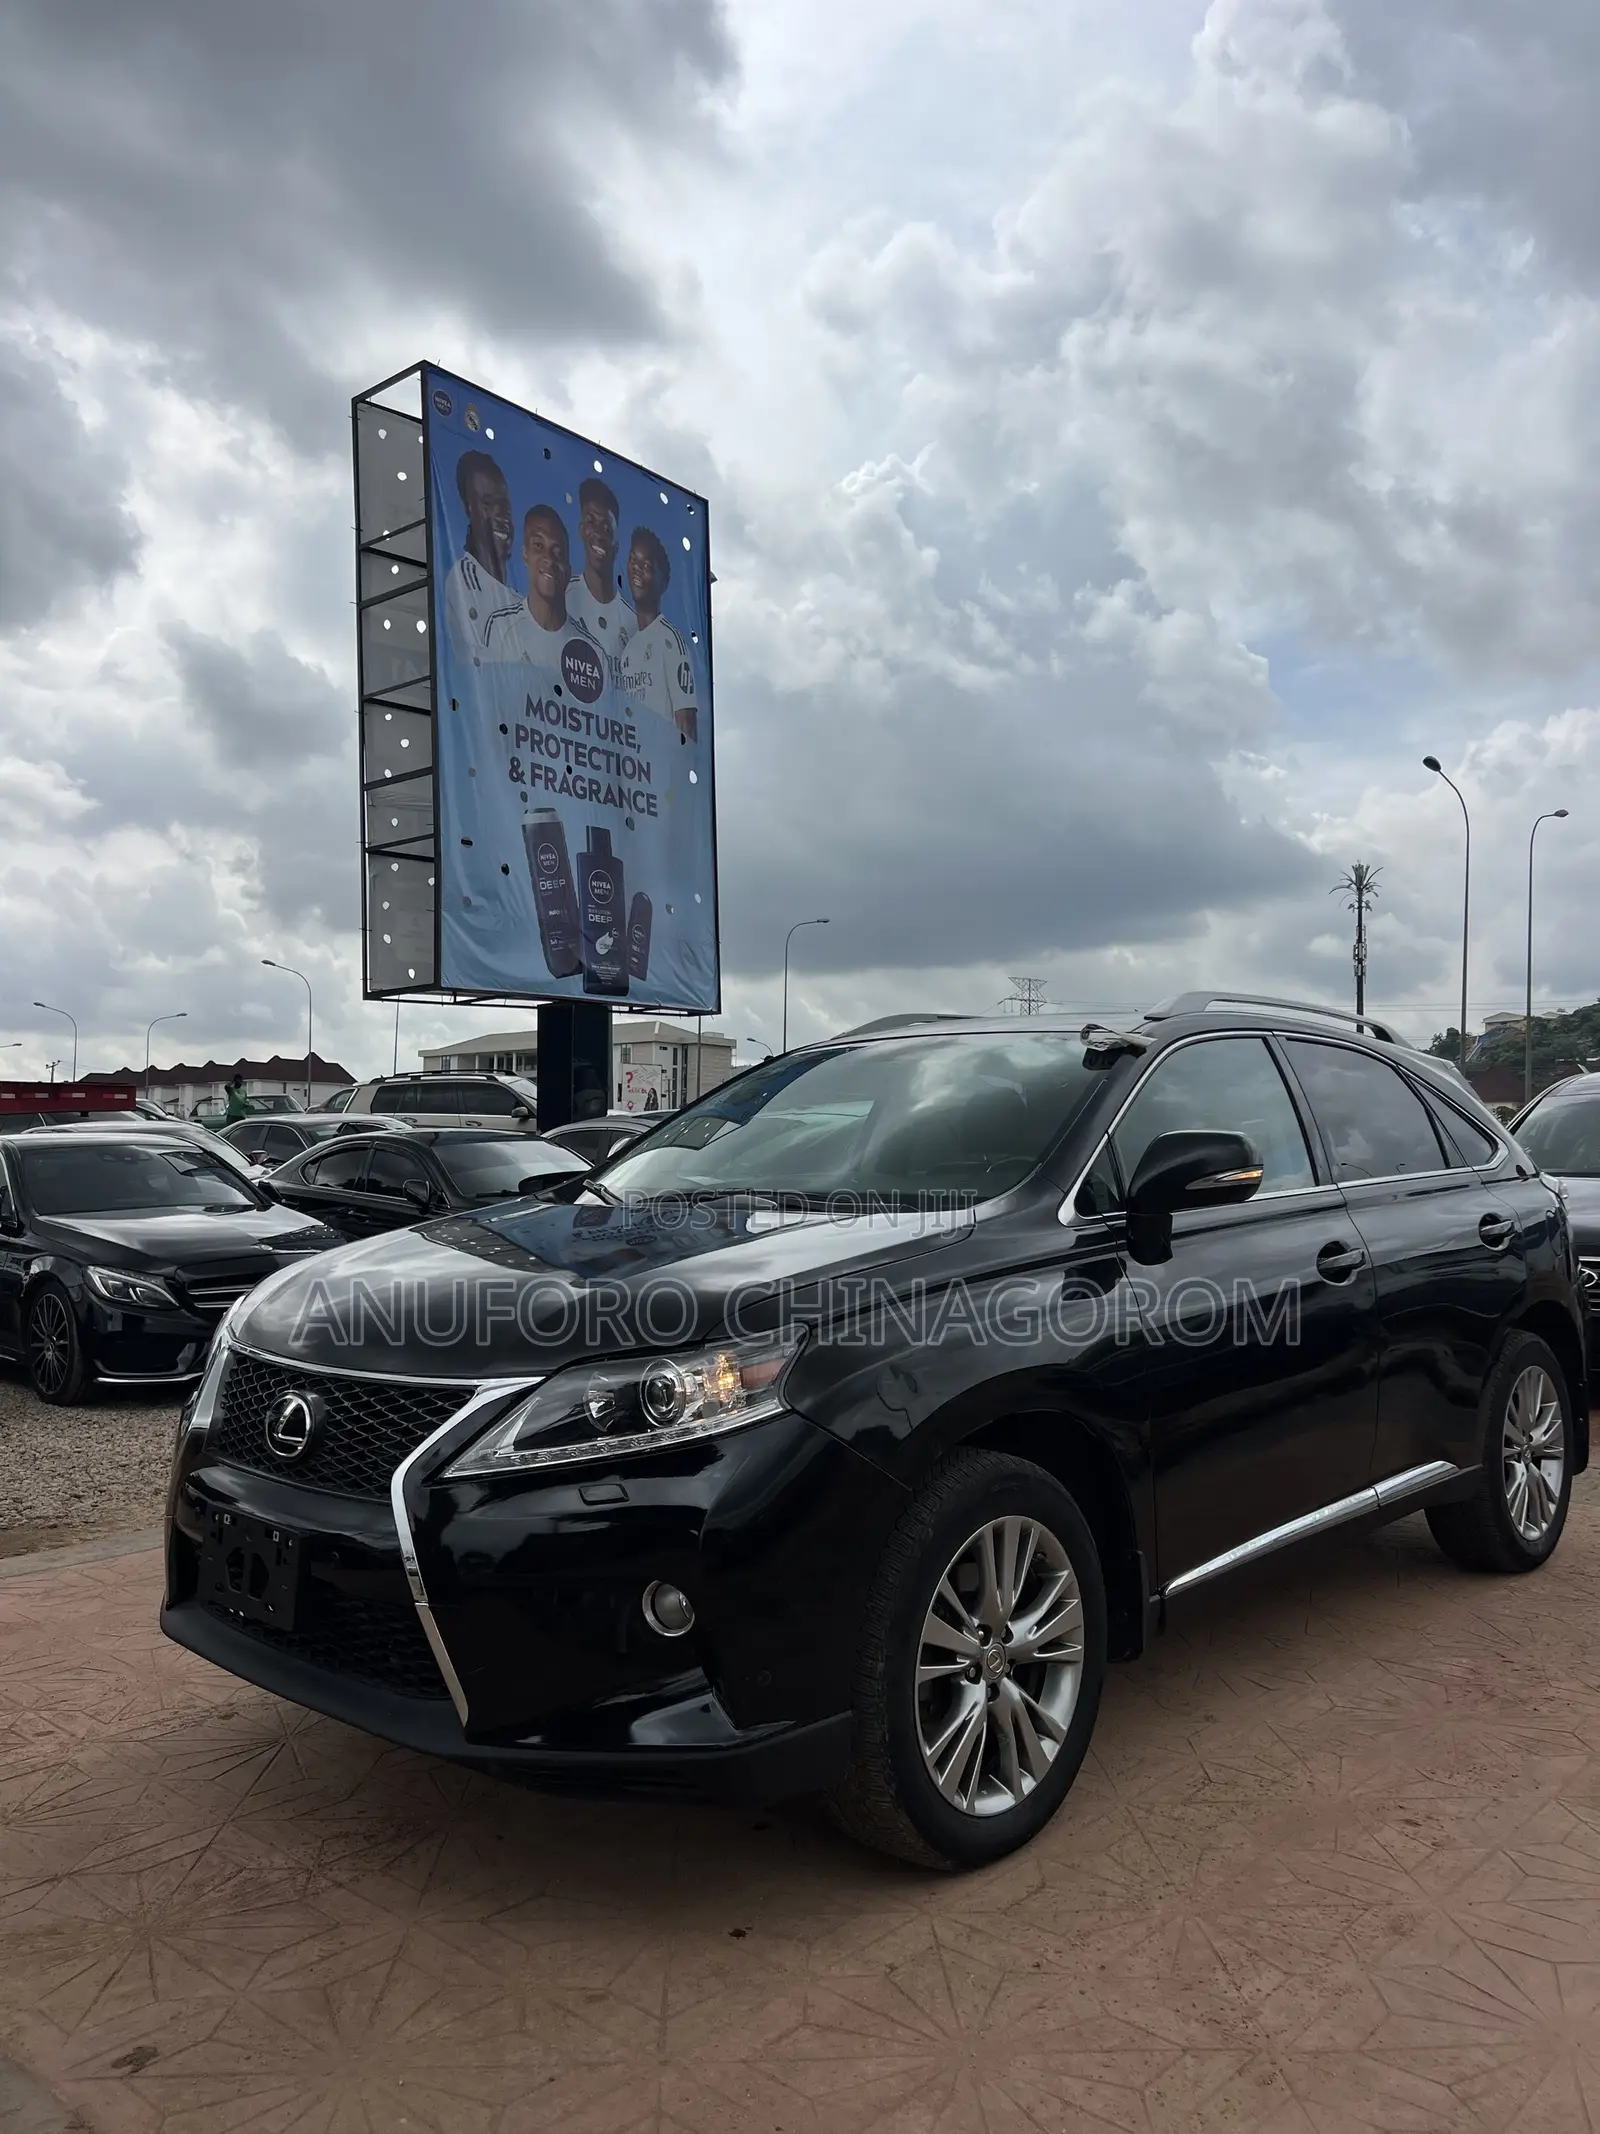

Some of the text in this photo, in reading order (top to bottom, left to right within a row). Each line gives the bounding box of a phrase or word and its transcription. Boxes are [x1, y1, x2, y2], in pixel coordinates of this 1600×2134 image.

[565, 656, 600, 680] NIVEA
[570, 673, 596, 691] MEN
[525, 693, 642, 754] MOISTURE,
[515, 723, 652, 785] PROTECTION
[509, 756, 658, 818] & FRAGRANCE
[540, 853, 556, 861] NIVEA
[539, 879, 566, 891] DEEP
[591, 880, 611, 889] NIVEA
[588, 914, 613, 923] DEEP
